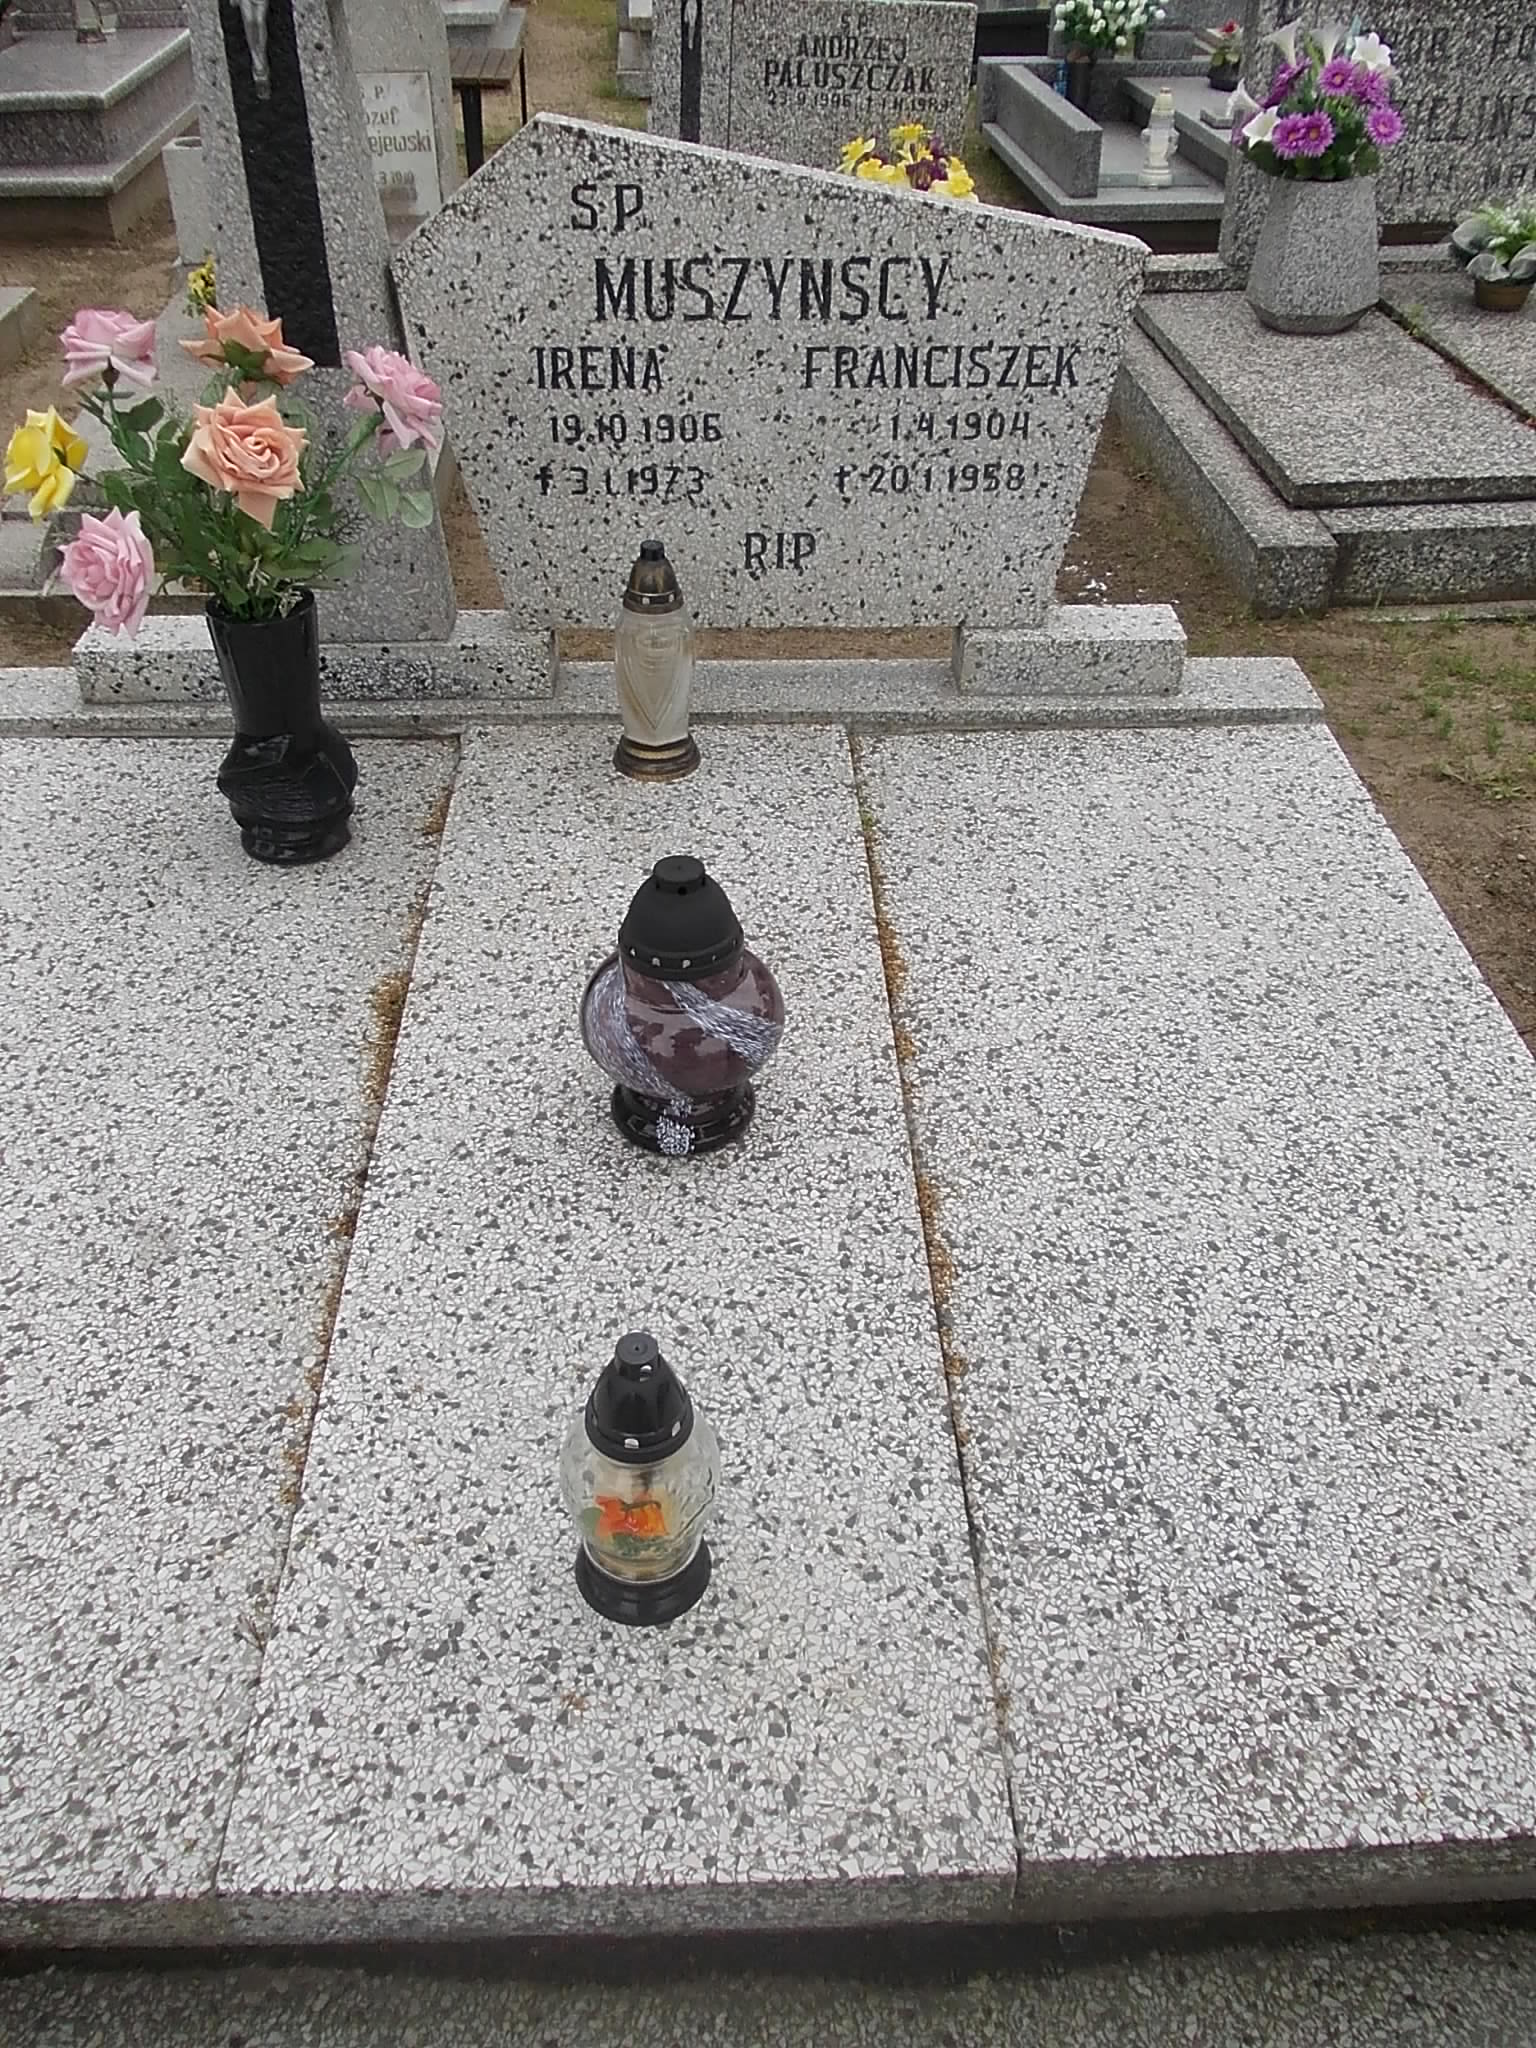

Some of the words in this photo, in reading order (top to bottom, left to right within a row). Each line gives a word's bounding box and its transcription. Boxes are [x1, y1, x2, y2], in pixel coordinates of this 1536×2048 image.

[797, 33, 908, 62] ANDRZEJ
[763, 60, 936, 93] PALUSZCZAK
[530, 346, 663, 390] IRENA
[804, 345, 1083, 389] FRANCISZEK
[745, 532, 816, 570] RIP
